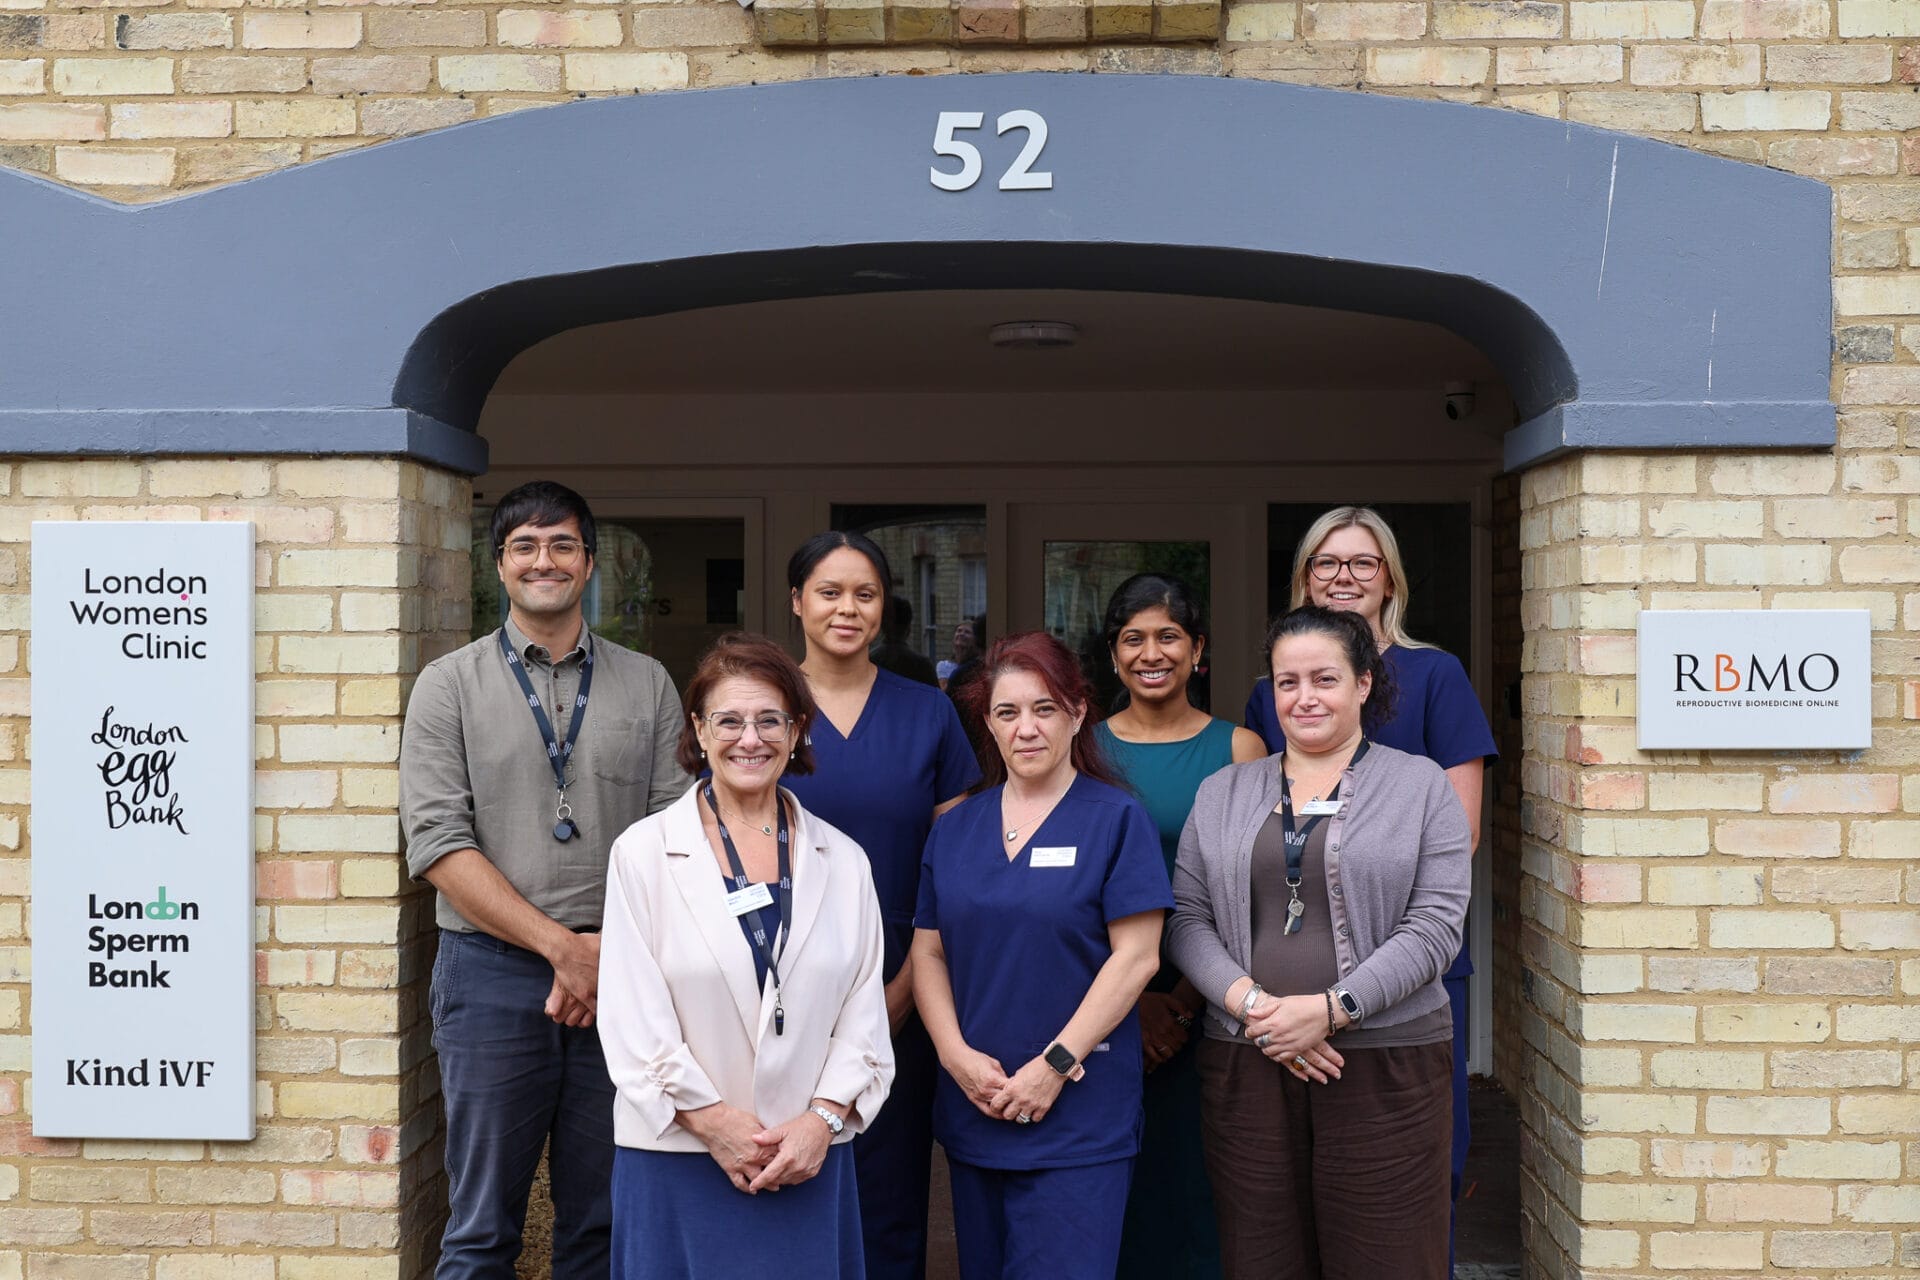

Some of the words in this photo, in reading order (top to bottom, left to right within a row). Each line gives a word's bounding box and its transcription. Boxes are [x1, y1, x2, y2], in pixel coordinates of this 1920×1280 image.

[930, 109, 1053, 191] 52
[85, 567, 207, 594] London
[69, 600, 208, 625] Womens
[121, 632, 207, 659] Clinic
[1673, 652, 1840, 693] RBMO
[1676, 699, 1742, 708] REPRODUCTIVE
[1745, 699, 1804, 708] BIOMEDICINE
[1806, 699, 1839, 707] ONLINE
[91, 705, 189, 749] London
[96, 749, 176, 805] egg
[106, 790, 190, 835] Bank
[89, 886, 199, 920] London
[88, 925, 189, 960] Sperm
[88, 960, 171, 988] Bank
[66, 1057, 149, 1087] Kind
[159, 1058, 215, 1088] iVF
